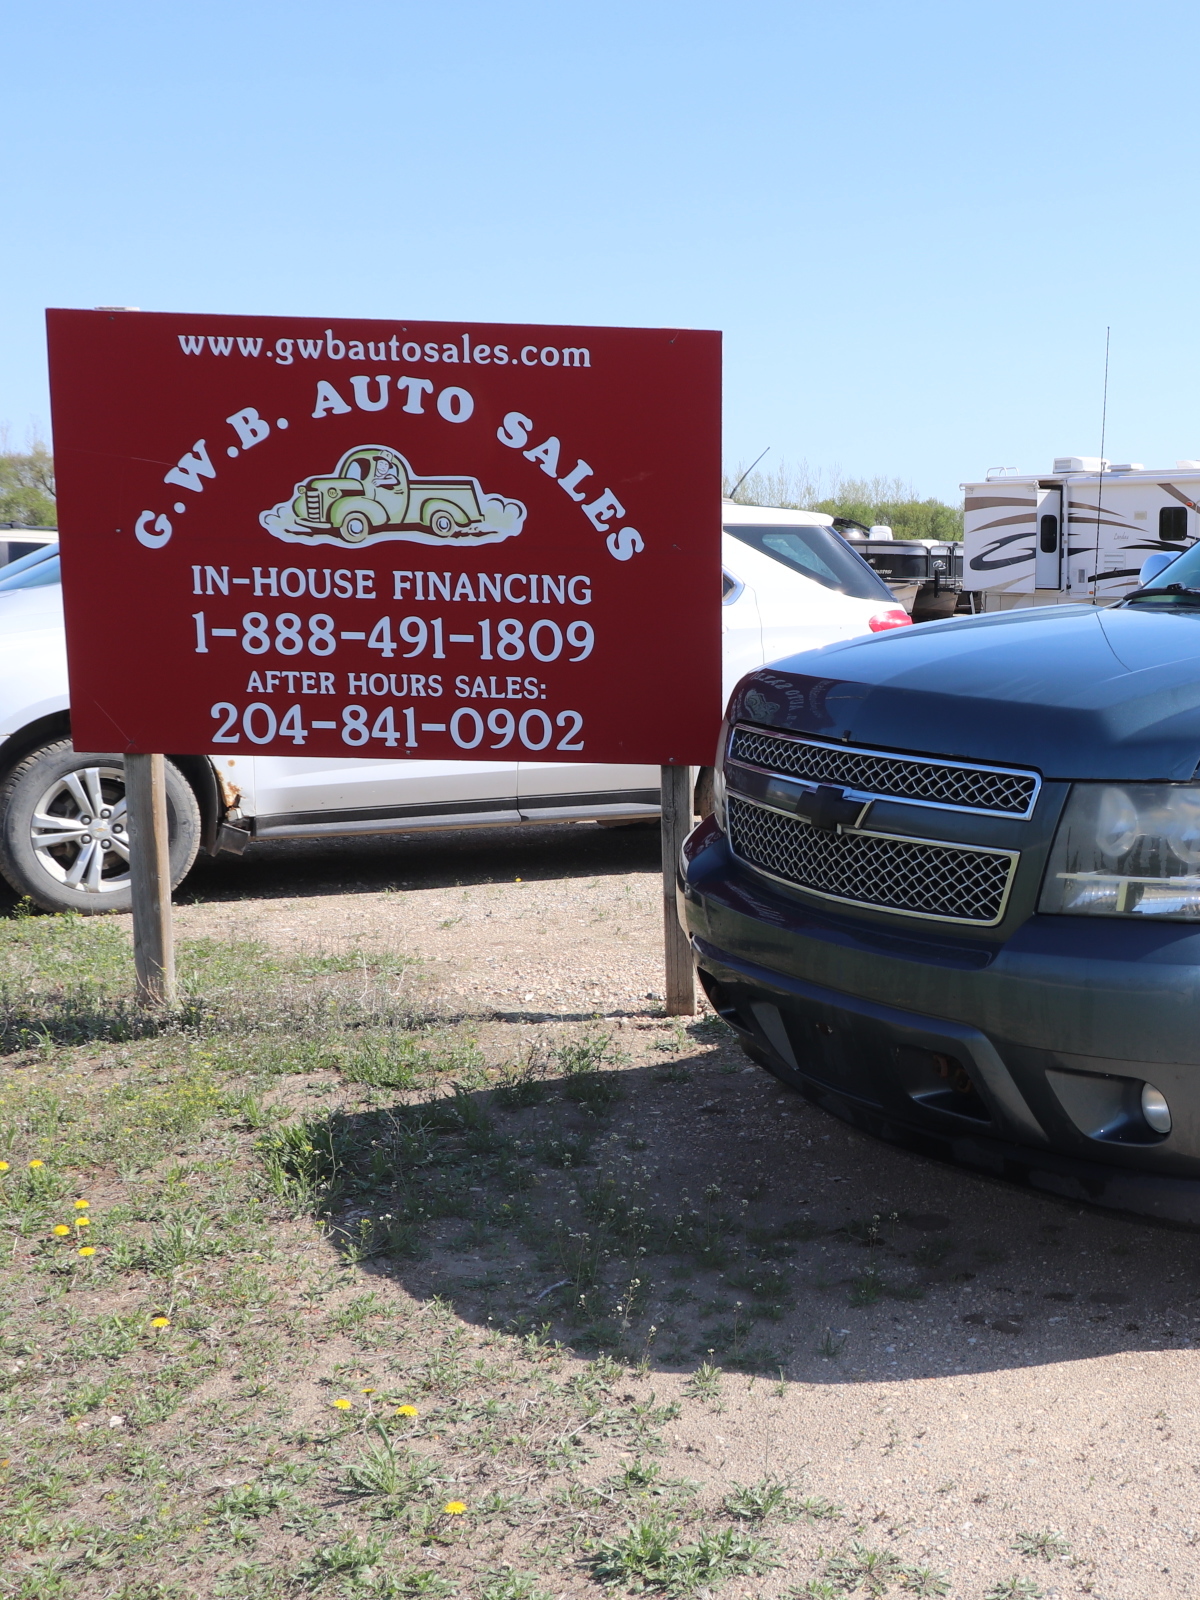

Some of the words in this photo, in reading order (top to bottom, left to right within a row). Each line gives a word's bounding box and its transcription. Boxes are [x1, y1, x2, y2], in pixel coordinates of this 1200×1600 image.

[177, 328, 592, 368] www.gwbautosales.com
[134, 407, 289, 549] G.W.B.
[311, 374, 475, 424] AUTO
[496, 411, 645, 562] SALES
[191, 565, 377, 600] IN-HOUSE
[392, 570, 592, 606] FINANCING
[191, 611, 595, 662] 1-888-491-1809
[246, 670, 336, 695] AFTER
[347, 672, 443, 697] HOURS
[454, 675, 547, 700] SALES:
[210, 701, 585, 751] 204-841-0902
